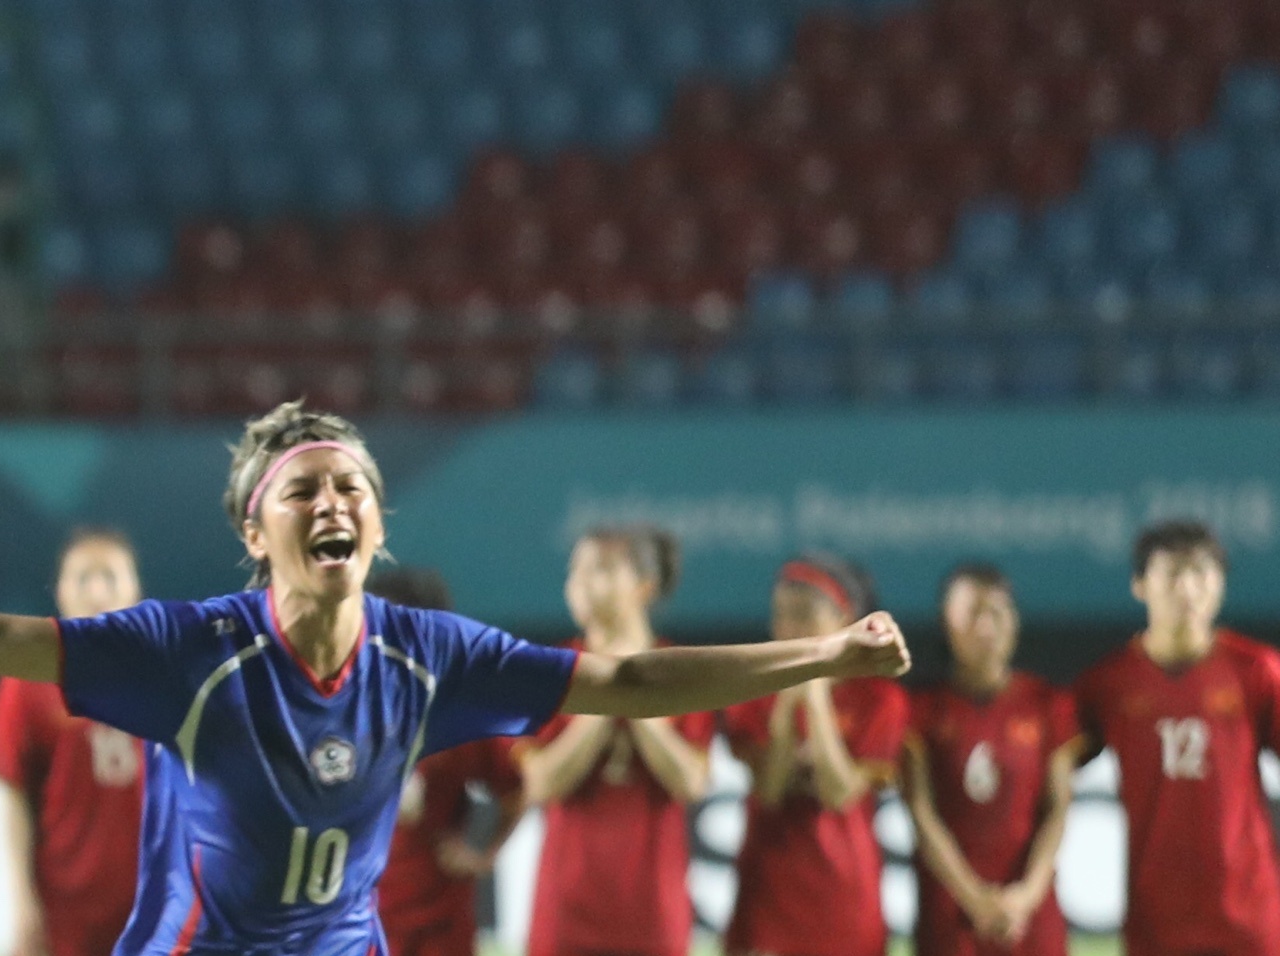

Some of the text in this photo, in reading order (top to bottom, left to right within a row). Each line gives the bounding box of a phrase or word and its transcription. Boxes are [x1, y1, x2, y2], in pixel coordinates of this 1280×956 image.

[963, 740, 1000, 803] 6
[1155, 717, 1210, 780] 12
[280, 826, 349, 905] 10
